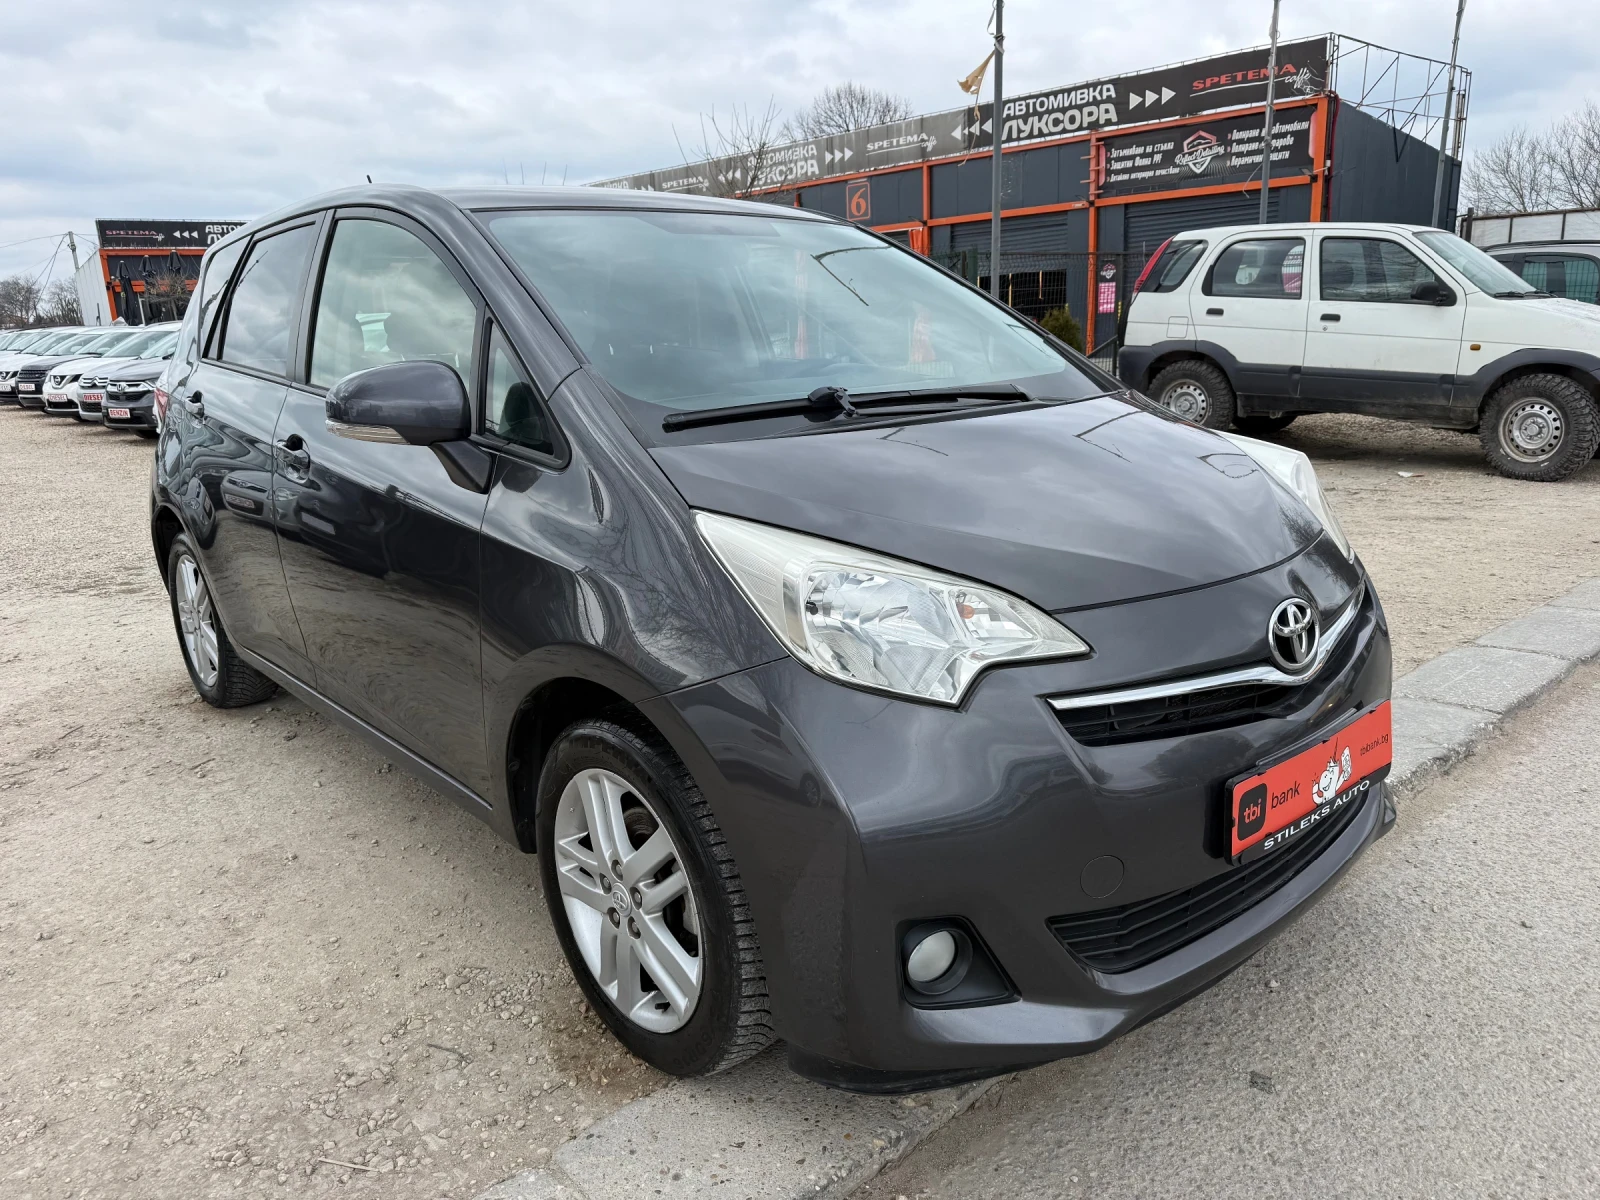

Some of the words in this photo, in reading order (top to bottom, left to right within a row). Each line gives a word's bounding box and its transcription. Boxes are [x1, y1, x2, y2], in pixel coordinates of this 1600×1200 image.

[1192, 63, 1297, 90] SPETEMA
[1002, 83, 1117, 119] АВТОМИВКА
[1001, 102, 1118, 141] ЛУКСОРА
[866, 132, 929, 151] SPETEMA
[1269, 150, 1290, 161] ащити
[661, 175, 704, 189] SPETEMA
[851, 187, 867, 216] 6
[205, 224, 241, 234] АВТО
[1243, 799, 1262, 824] tbi
[1270, 780, 1301, 810] bank
[1263, 804, 1330, 851] STILEKS
[1333, 780, 1370, 810] AUTO
